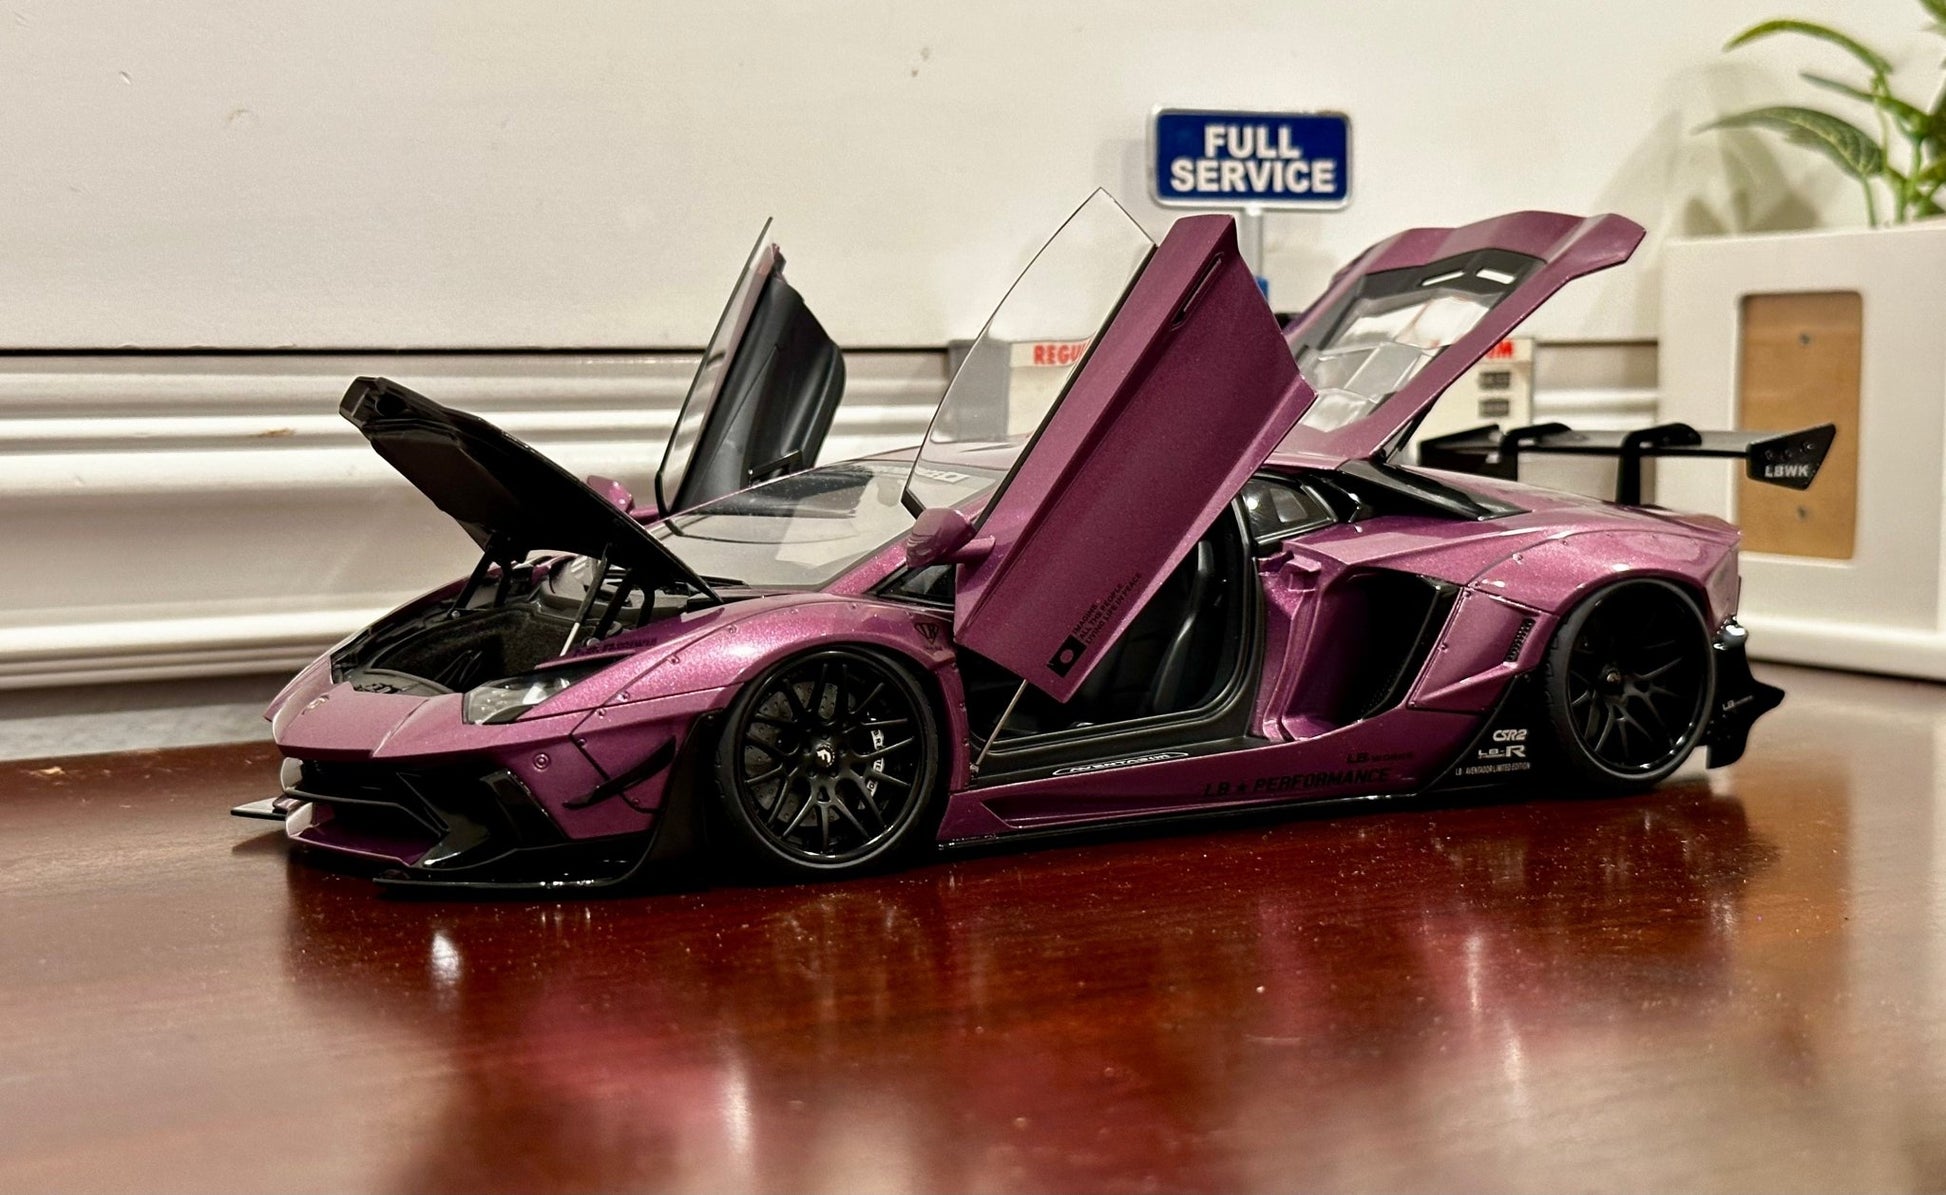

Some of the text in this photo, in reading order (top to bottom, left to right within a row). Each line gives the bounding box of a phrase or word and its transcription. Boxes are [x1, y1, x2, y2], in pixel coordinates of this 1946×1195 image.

[1204, 125, 1302, 159] FULL
[1170, 158, 1337, 193] SERVICE
[1034, 344, 1087, 365] REGU
[1764, 464, 1809, 478] LBWK
[1079, 626, 1091, 640] ALL
[1100, 582, 1124, 611] PEOPLE
[1492, 728, 1528, 742] CSR2
[1346, 752, 1369, 763] LB
[1204, 768, 1390, 797] LB PERFORMANCE
